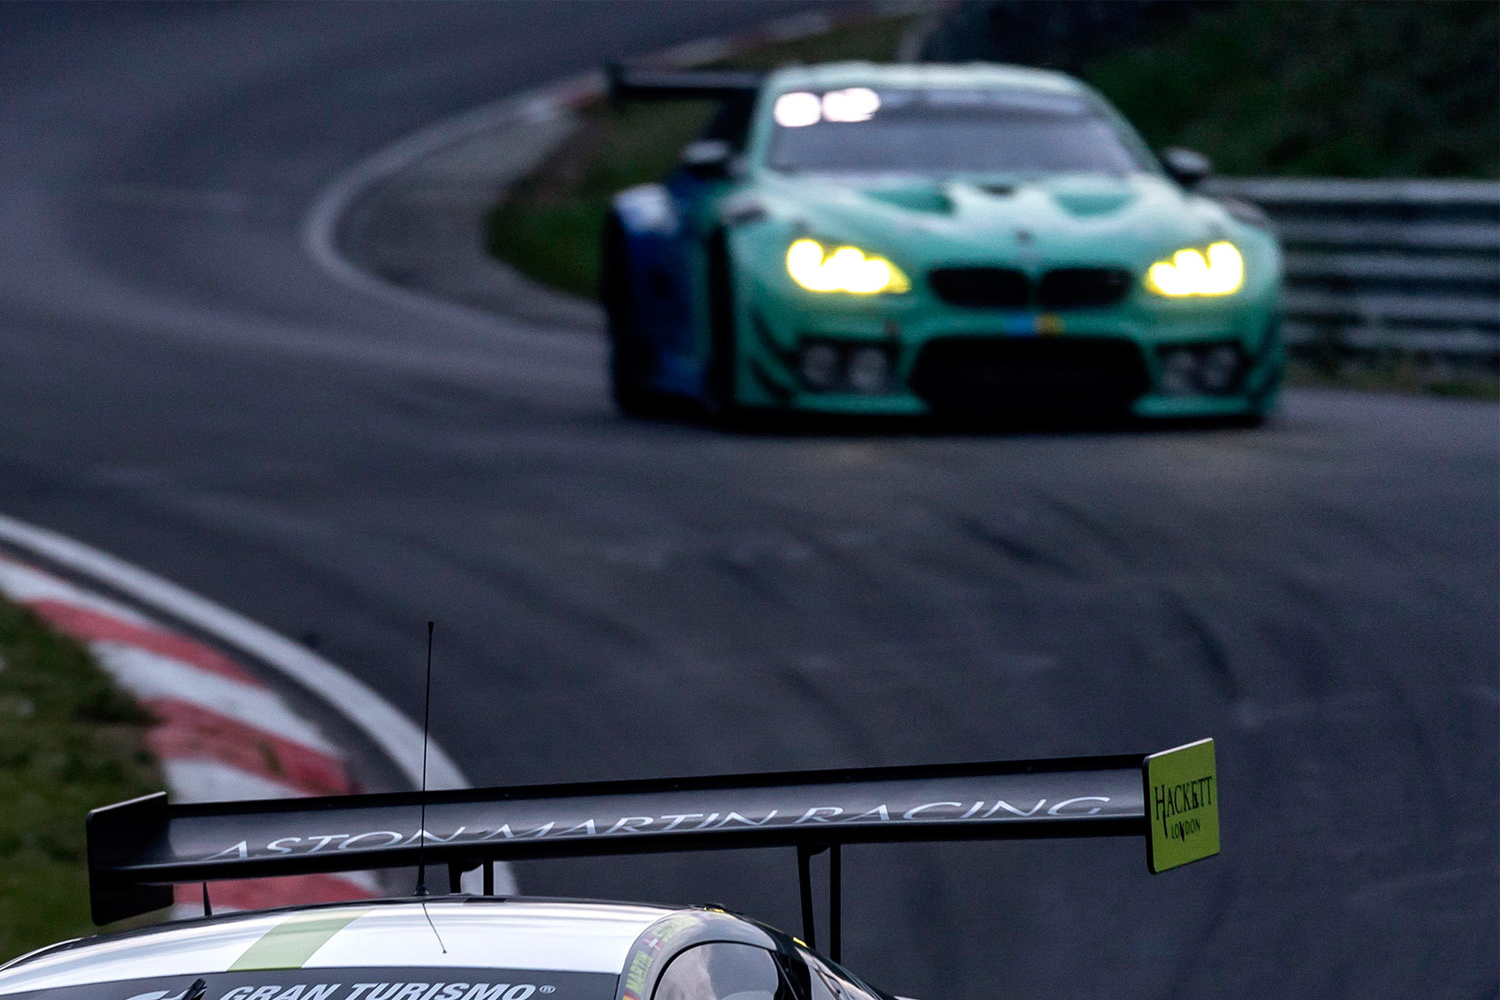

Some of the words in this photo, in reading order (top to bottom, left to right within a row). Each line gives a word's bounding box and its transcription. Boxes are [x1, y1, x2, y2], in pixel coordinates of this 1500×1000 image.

[1154, 776, 1212, 821] HACKETT
[202, 826, 465, 861] ASTON
[486, 810, 777, 840] MARTIN
[793, 796, 1110, 823] RACING
